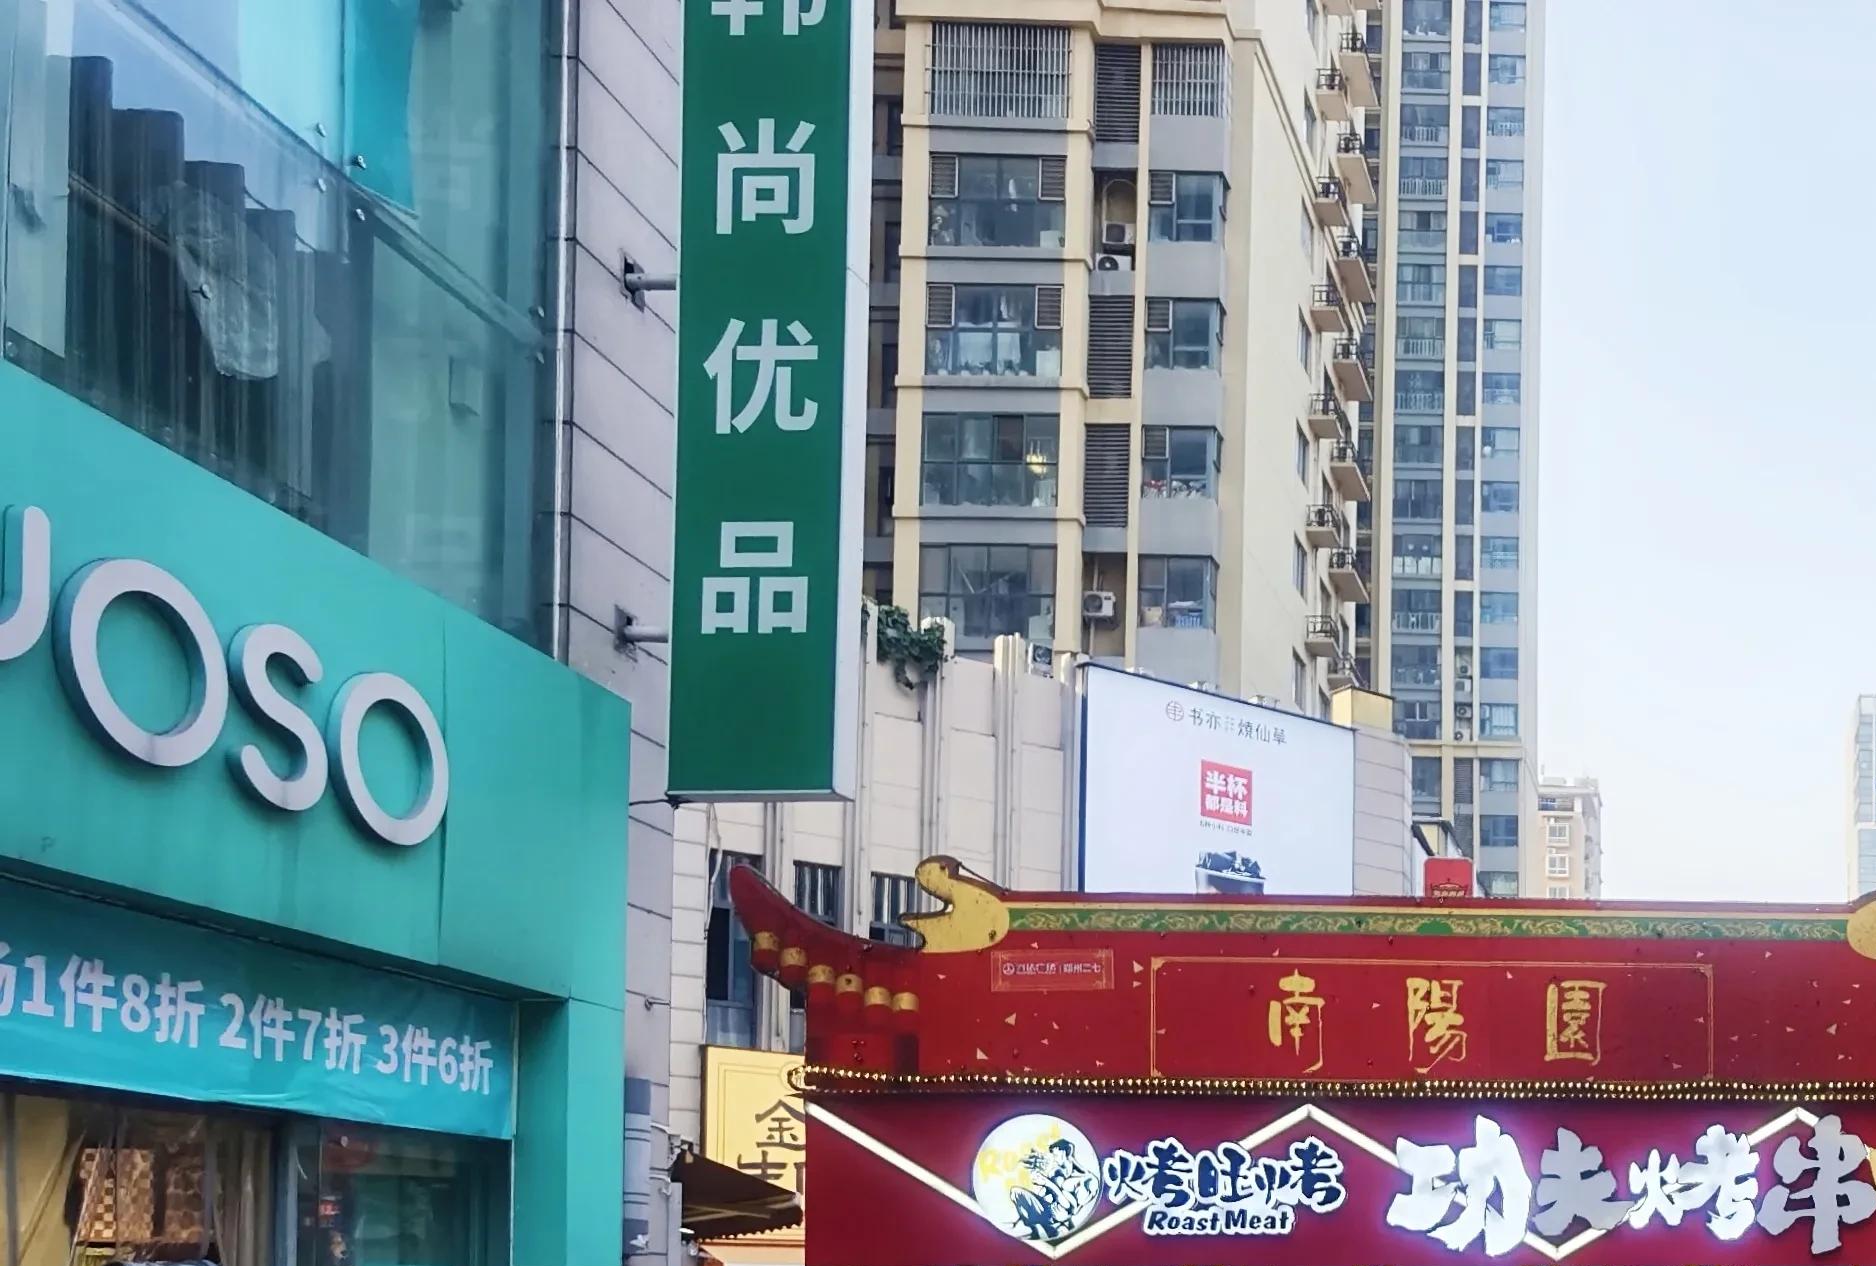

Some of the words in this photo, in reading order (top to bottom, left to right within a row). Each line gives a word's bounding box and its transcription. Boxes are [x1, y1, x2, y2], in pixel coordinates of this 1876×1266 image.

[0, 942, 206, 1049] 1件8折
[218, 992, 368, 1075] 2件7折
[375, 1023, 494, 1096] 3件6折
[1148, 1209, 1221, 1232] Roast
[1223, 1207, 1292, 1232] Meat
